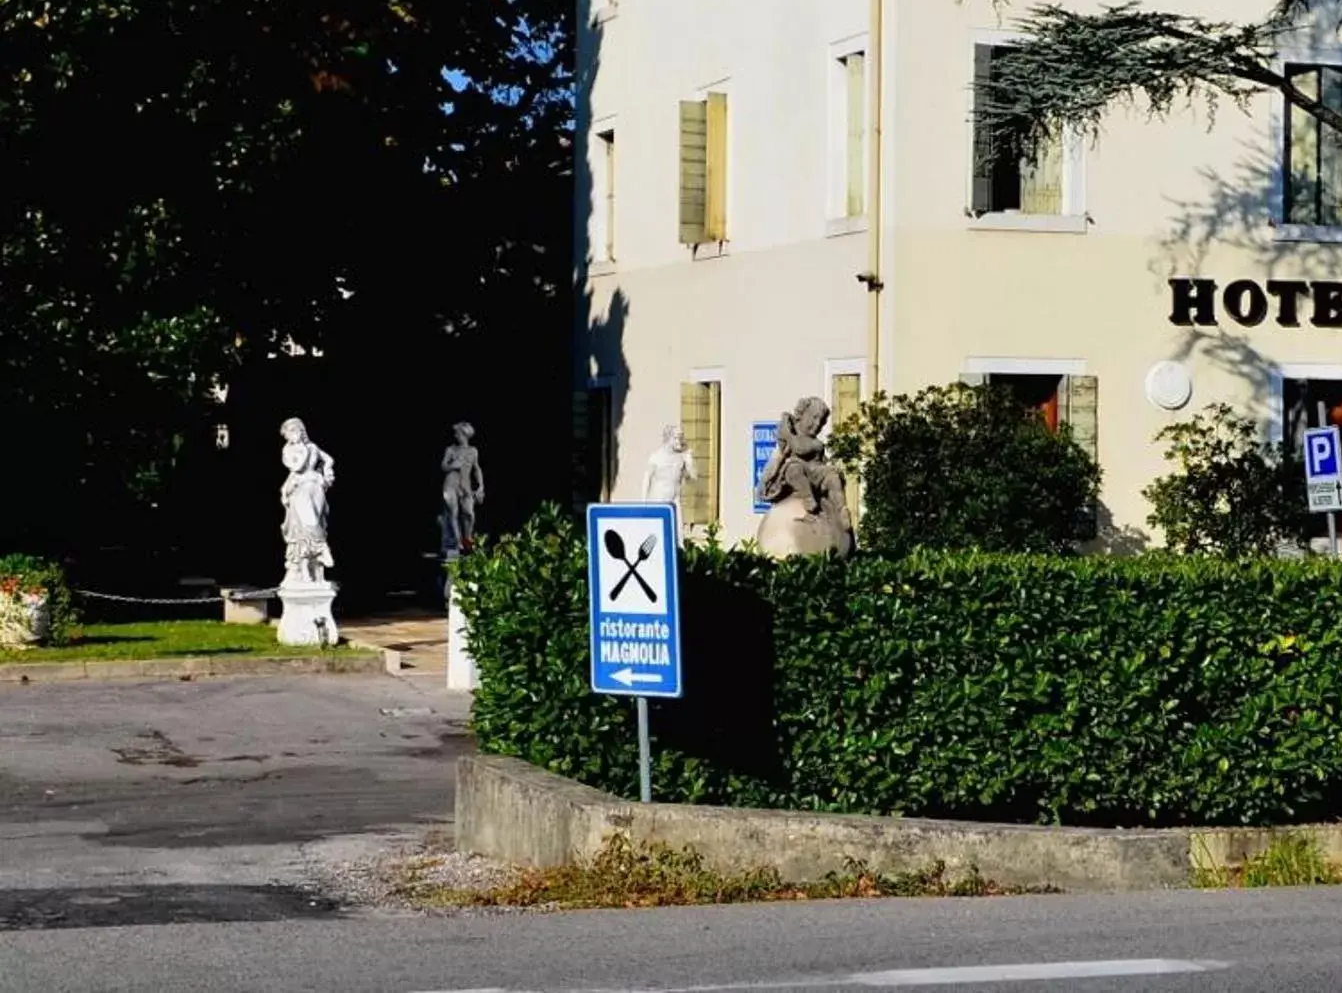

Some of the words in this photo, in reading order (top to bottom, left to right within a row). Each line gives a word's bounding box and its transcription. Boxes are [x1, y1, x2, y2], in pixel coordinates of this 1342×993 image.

[1312, 436, 1332, 473] P
[600, 617, 670, 640] ristorante
[601, 640, 670, 667] MAGNOLIA
